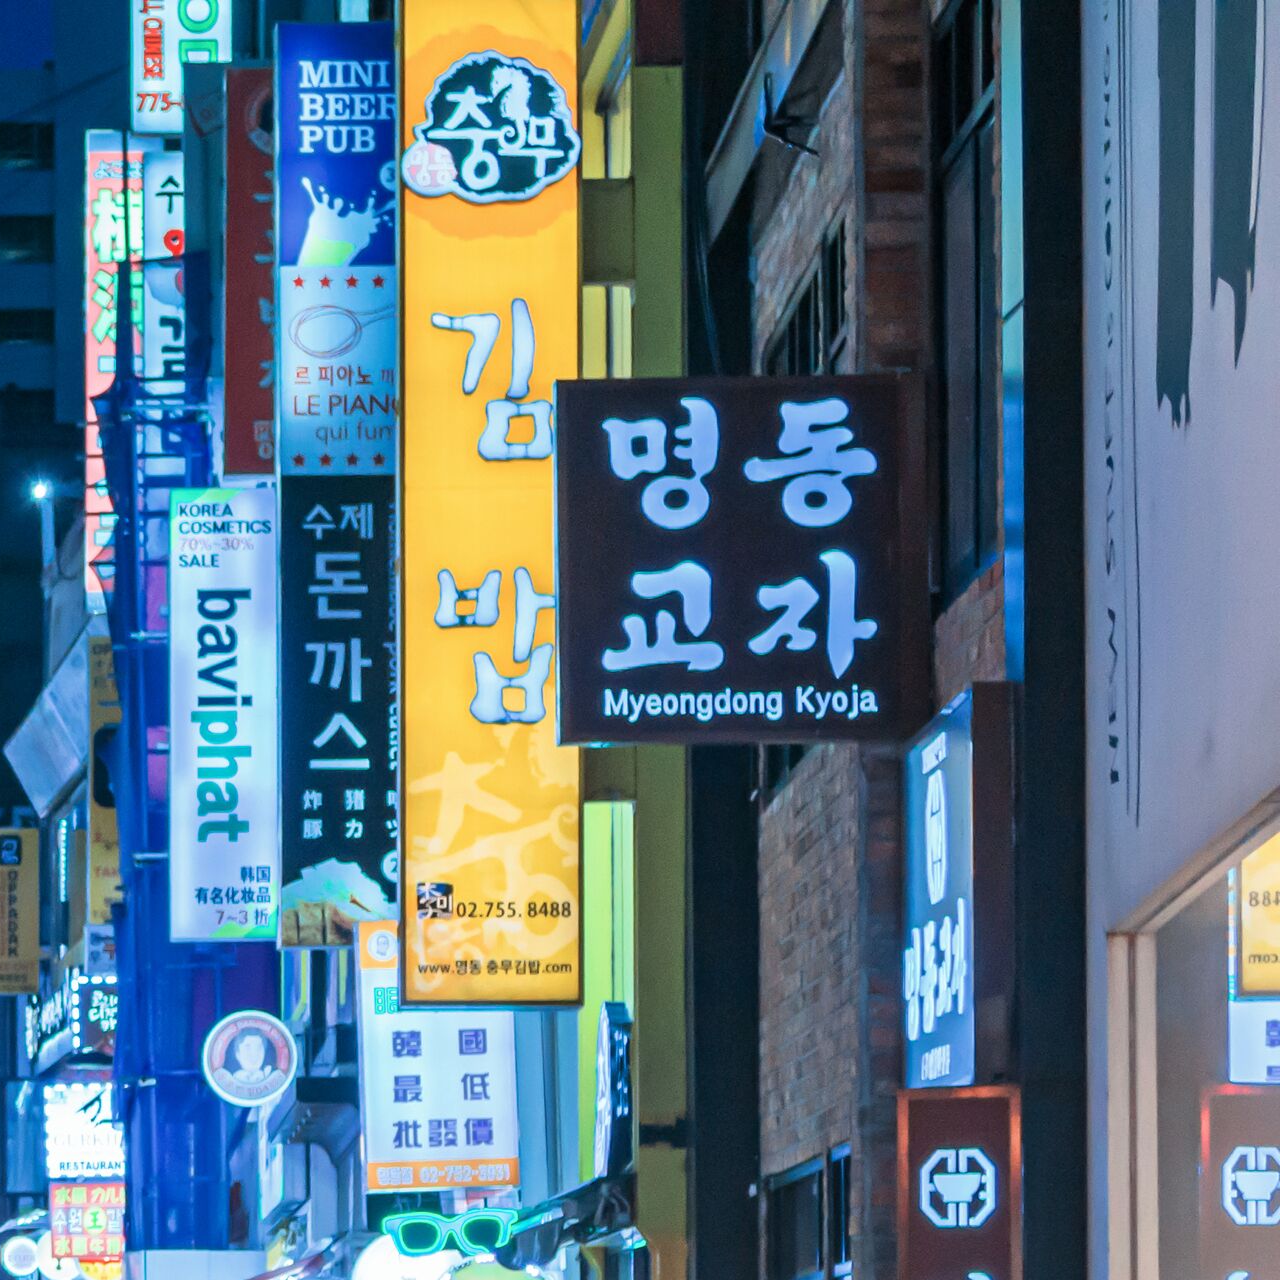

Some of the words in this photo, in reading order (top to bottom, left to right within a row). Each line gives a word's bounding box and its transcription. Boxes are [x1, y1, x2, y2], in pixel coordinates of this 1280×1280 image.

[299, 60, 390, 88] MINI
[299, 125, 376, 153] PUB
[293, 395, 321, 416] LE
[602, 397, 878, 530] 명동
[179, 504, 233, 517] KOREA
[302, 503, 374, 540] 수제
[178, 520, 272, 535] COSMETICS
[178, 554, 220, 568] SALE
[601, 548, 878, 679] 교자
[306, 551, 372, 770] 돈까스
[191, 588, 252, 842] baviphat
[604, 687, 784, 723] Myeongdong
[796, 685, 878, 717] Kyoja
[240, 865, 271, 883] 韩国
[194, 886, 271, 905] 有名化妆品
[527, 901, 572, 918] 8488
[393, 1072, 490, 1103] 最低
[392, 1117, 494, 1149] 批發價
[59, 1161, 122, 1172] RESTAURAN
